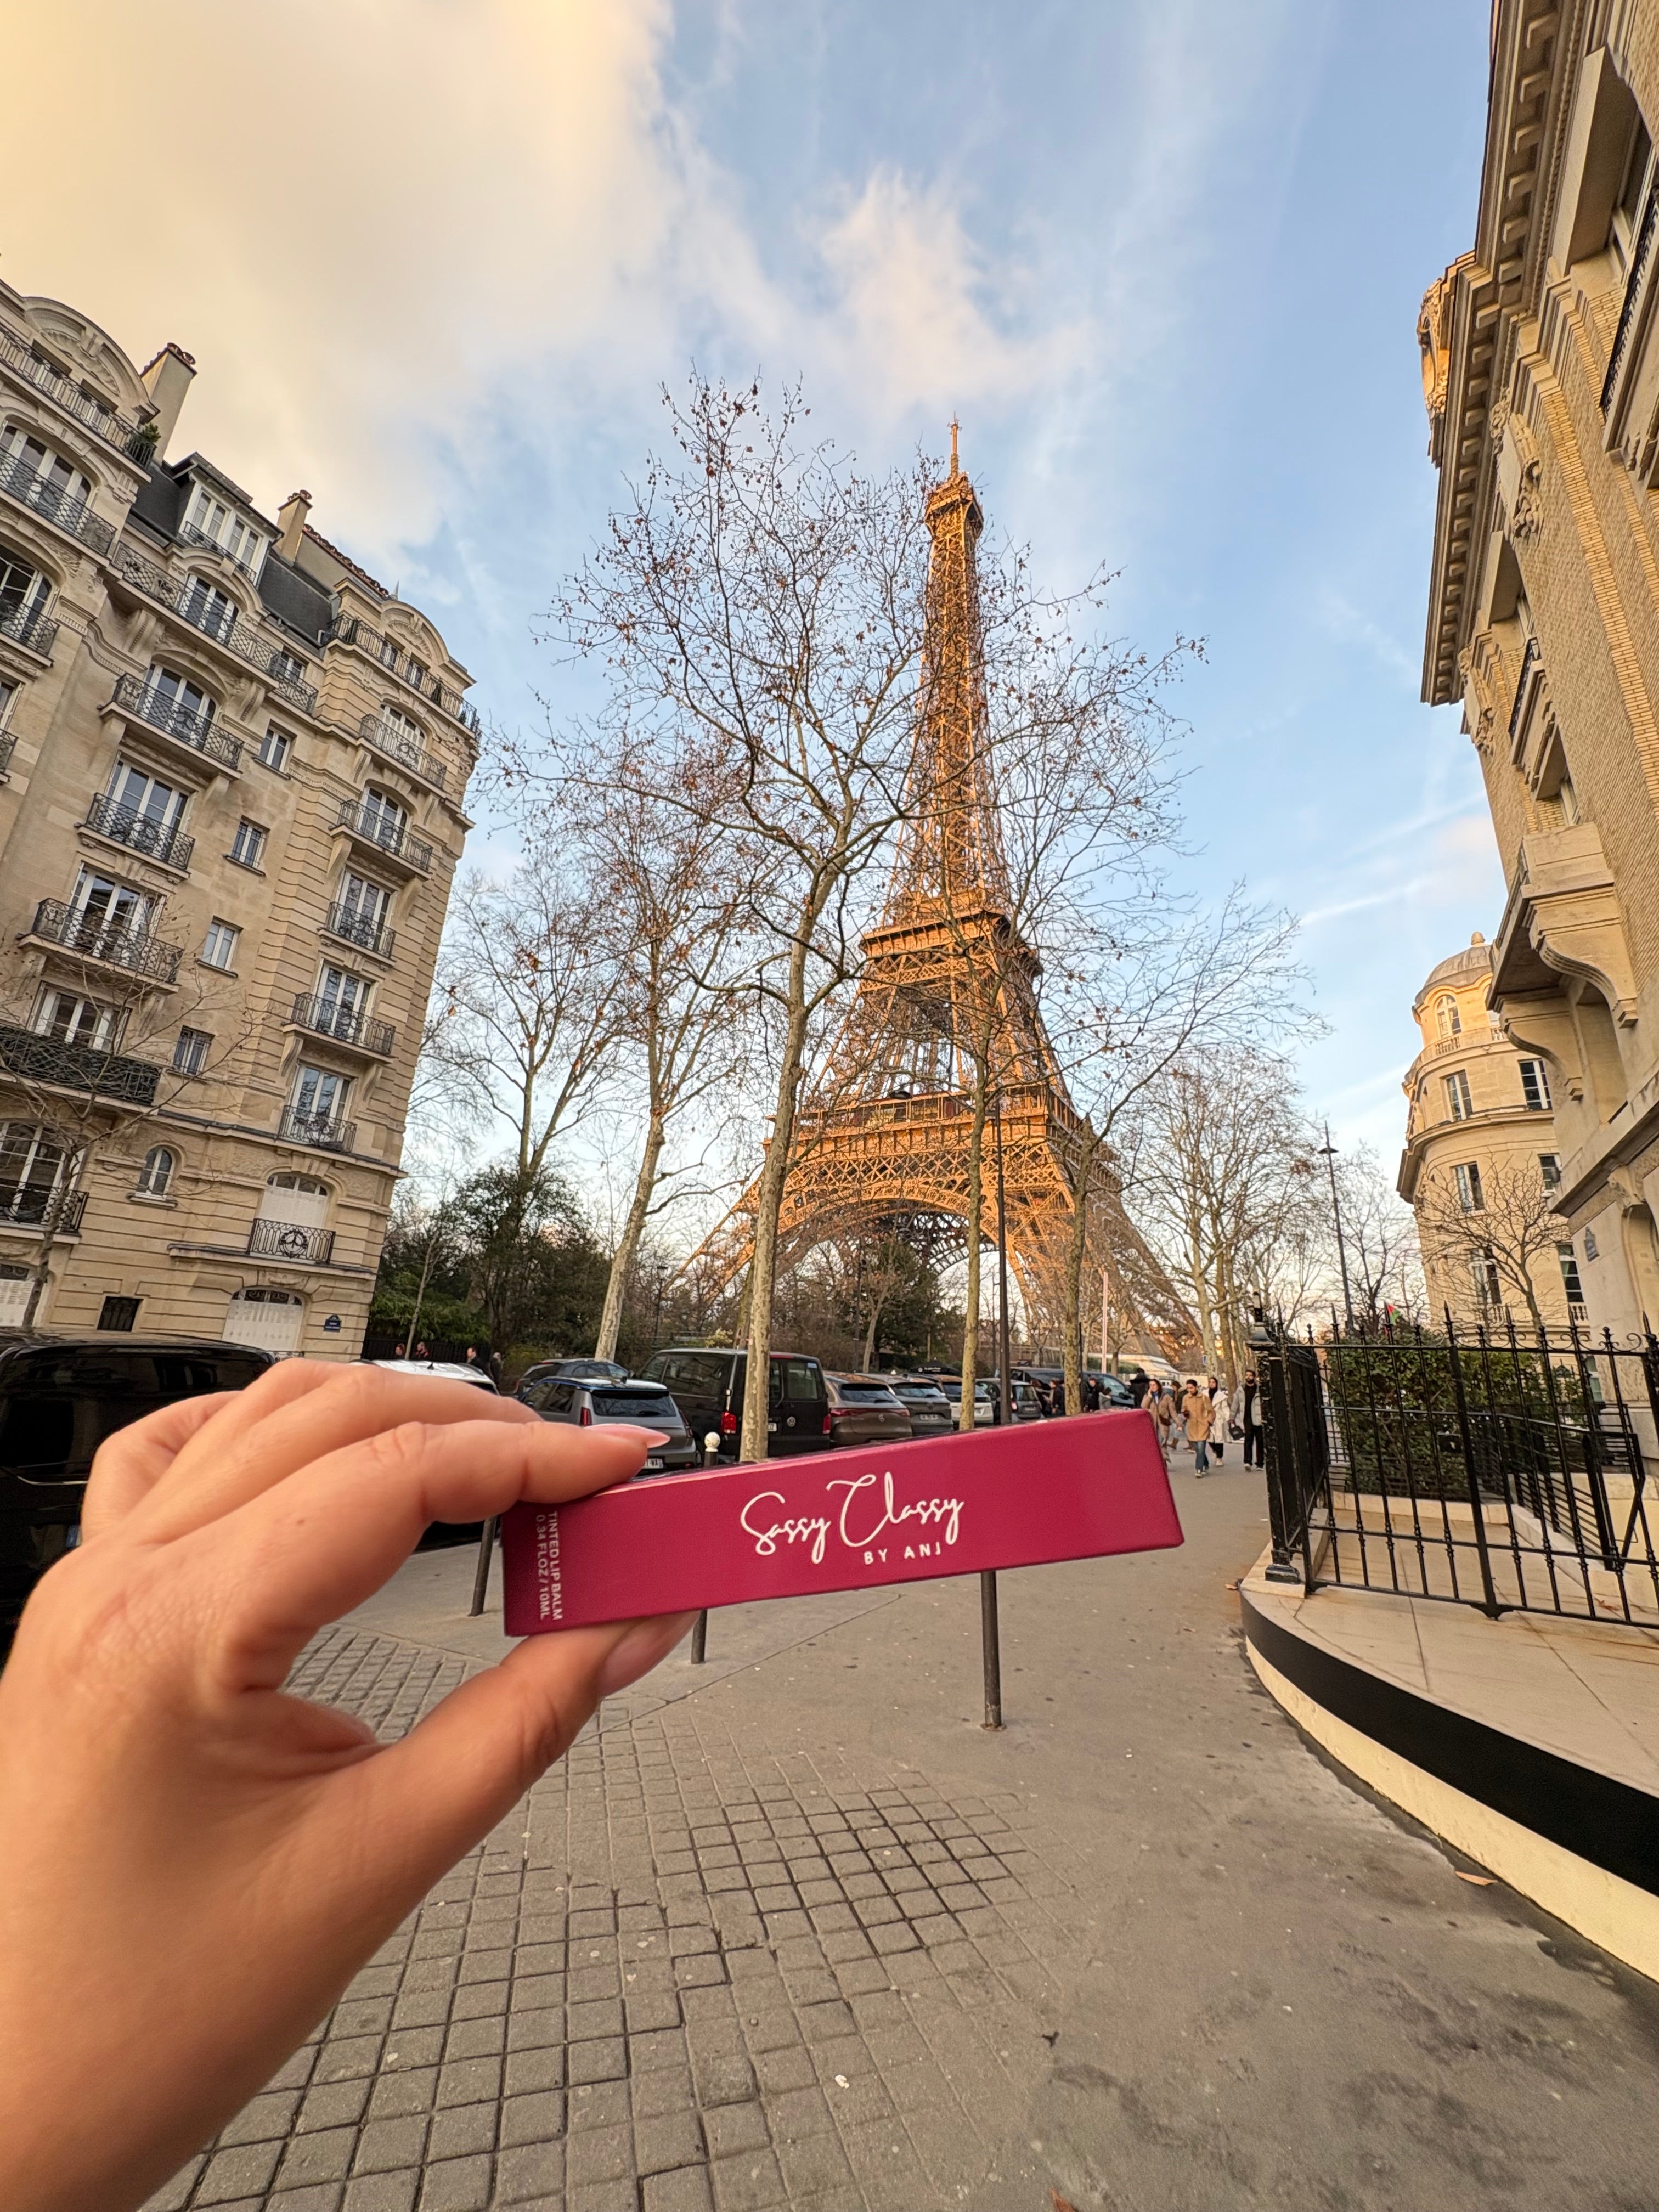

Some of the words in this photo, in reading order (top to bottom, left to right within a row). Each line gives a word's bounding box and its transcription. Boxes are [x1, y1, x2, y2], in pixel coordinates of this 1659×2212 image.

[536, 1514, 546, 1540] 0.34
[548, 1511, 559, 1558] TINTED
[740, 1491, 832, 1565] Sassy
[826, 1471, 964, 1548] Classy
[550, 1560, 560, 1581] LIP
[864, 1548, 888, 1565] BY
[904, 1542, 941, 1559] ANJ
[539, 1587, 550, 1621] 10ML
[551, 1583, 562, 1620] BALM
